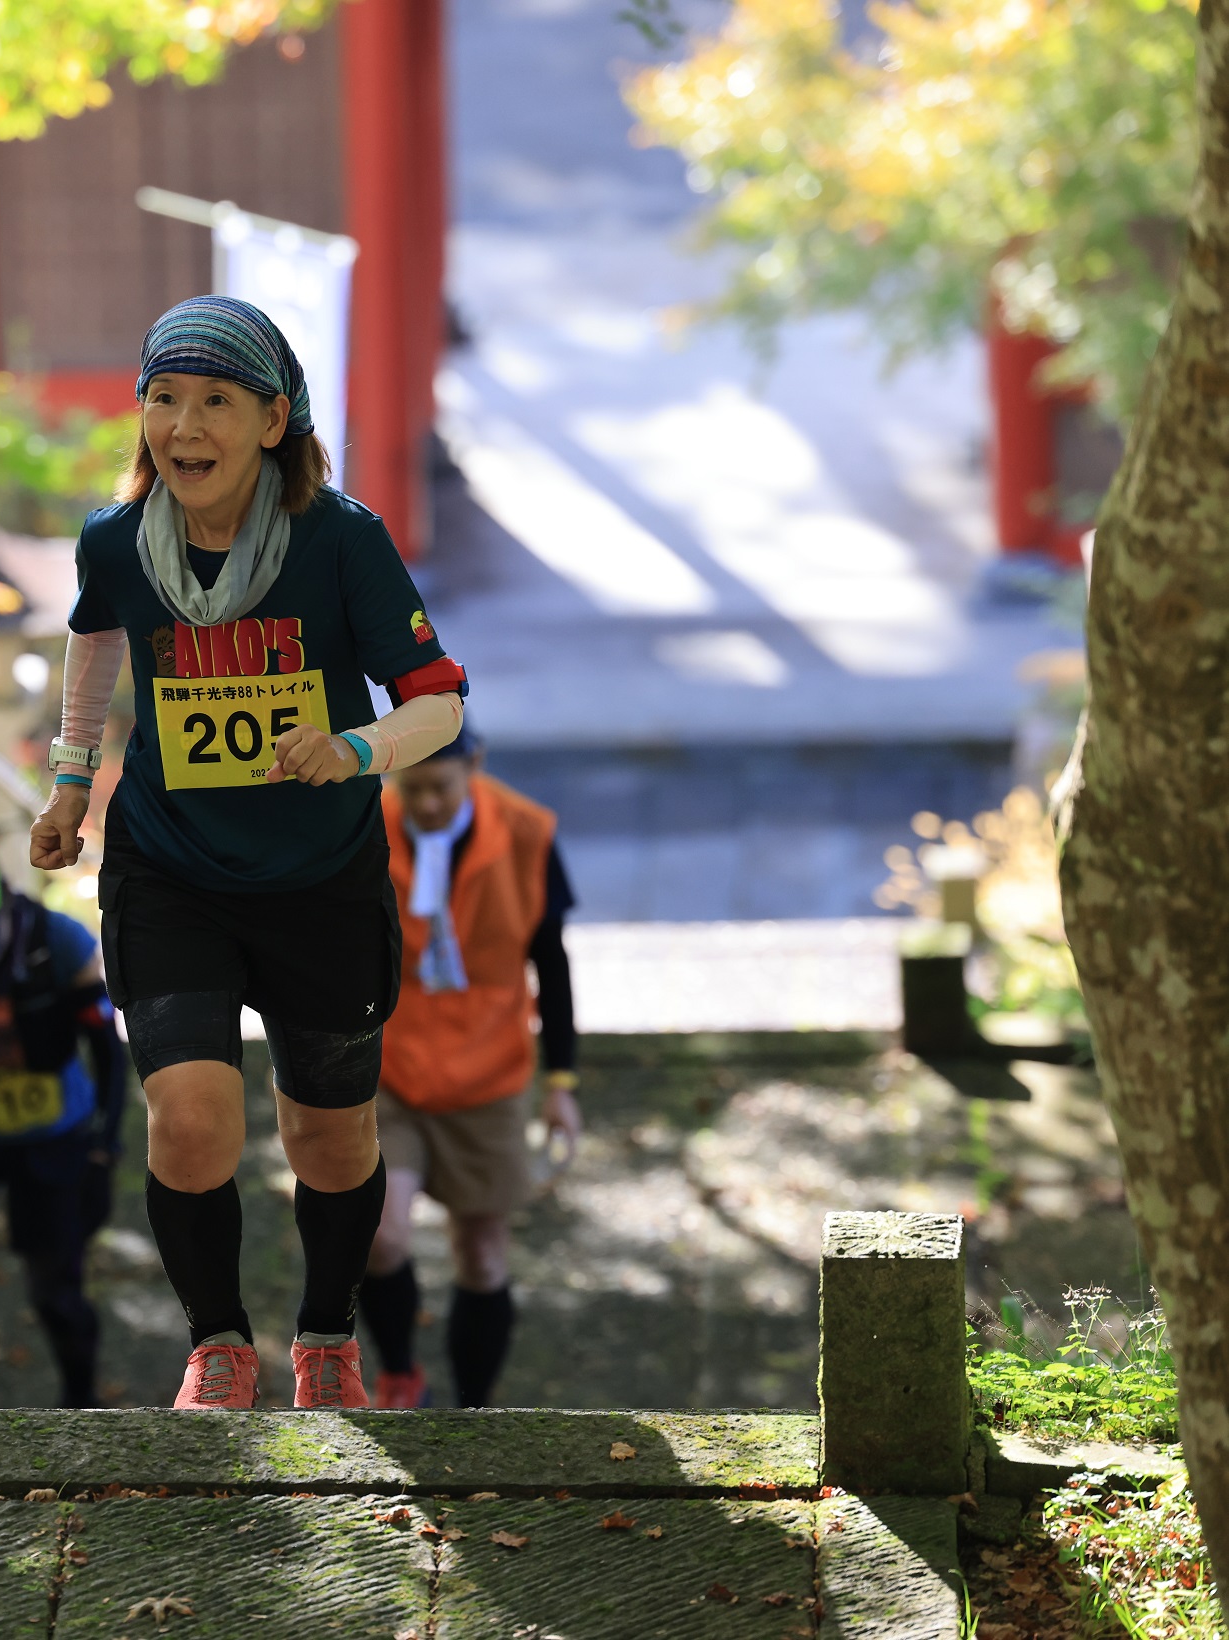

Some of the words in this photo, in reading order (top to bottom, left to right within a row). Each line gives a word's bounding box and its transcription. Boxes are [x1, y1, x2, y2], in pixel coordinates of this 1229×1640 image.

[174, 617, 305, 678] AIKO'S
[161, 680, 315, 702] 飛騨千光寺88トレイル
[250, 767, 271, 778] 202
